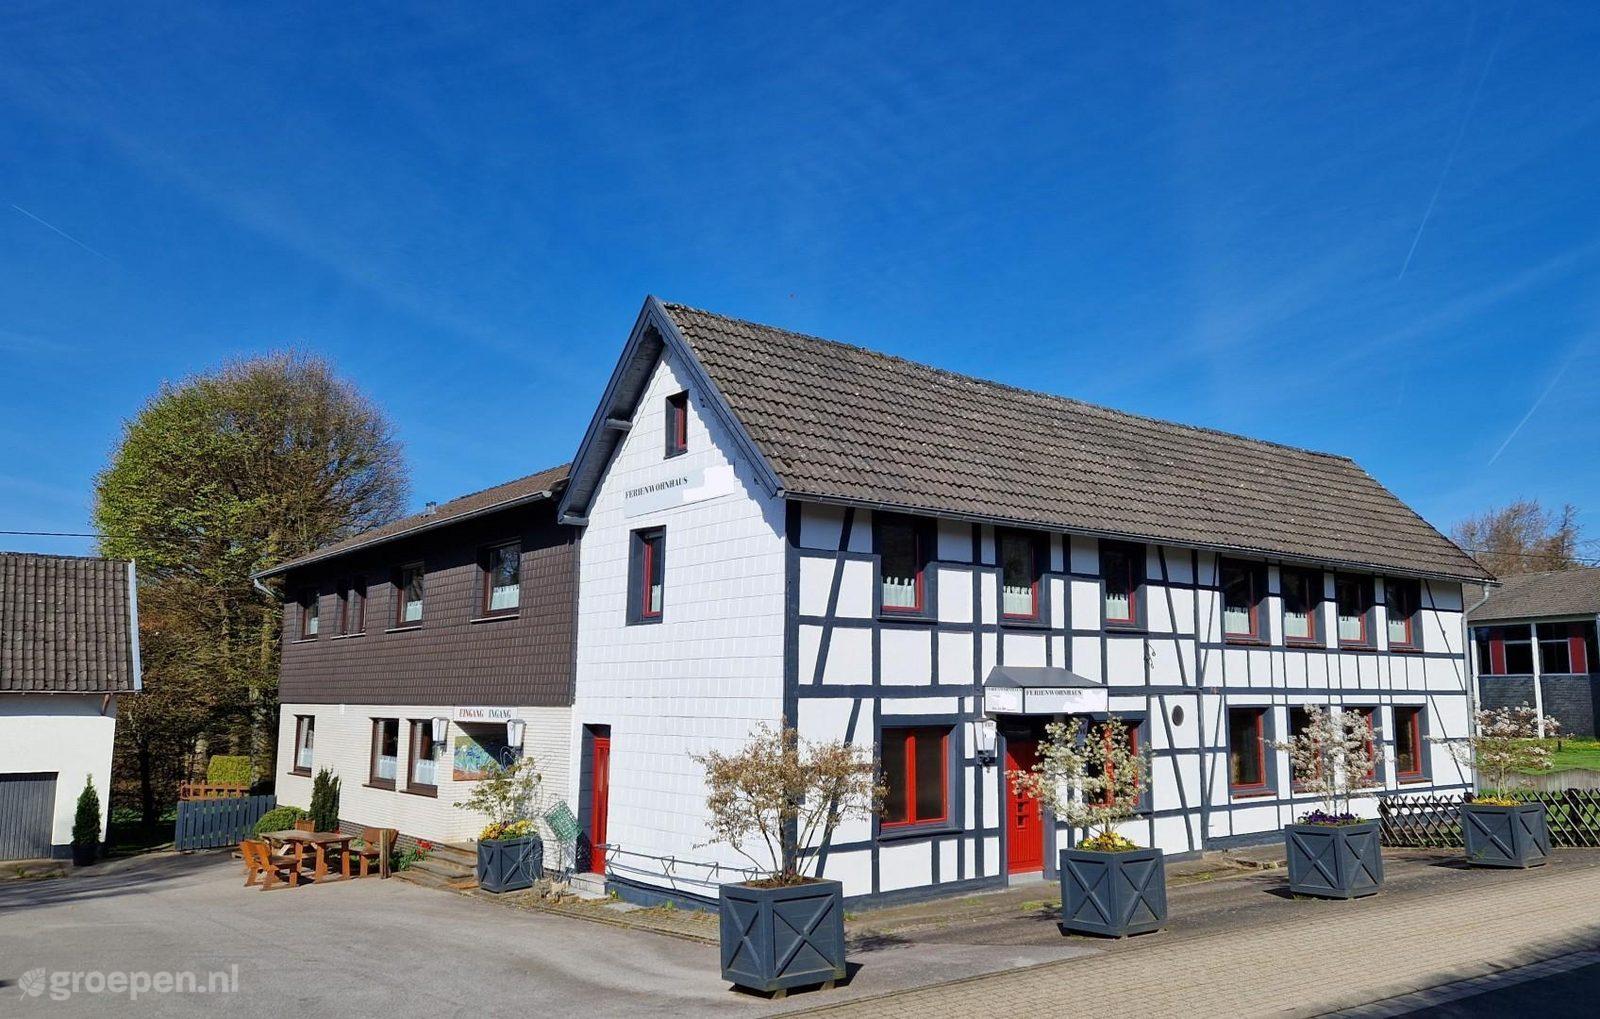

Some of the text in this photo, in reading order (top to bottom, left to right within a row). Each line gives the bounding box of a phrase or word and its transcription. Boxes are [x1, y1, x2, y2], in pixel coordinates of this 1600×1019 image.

[625, 476, 688, 499] FERIENWOHNHAUS
[459, 708, 511, 718] EINGANG INGANG
